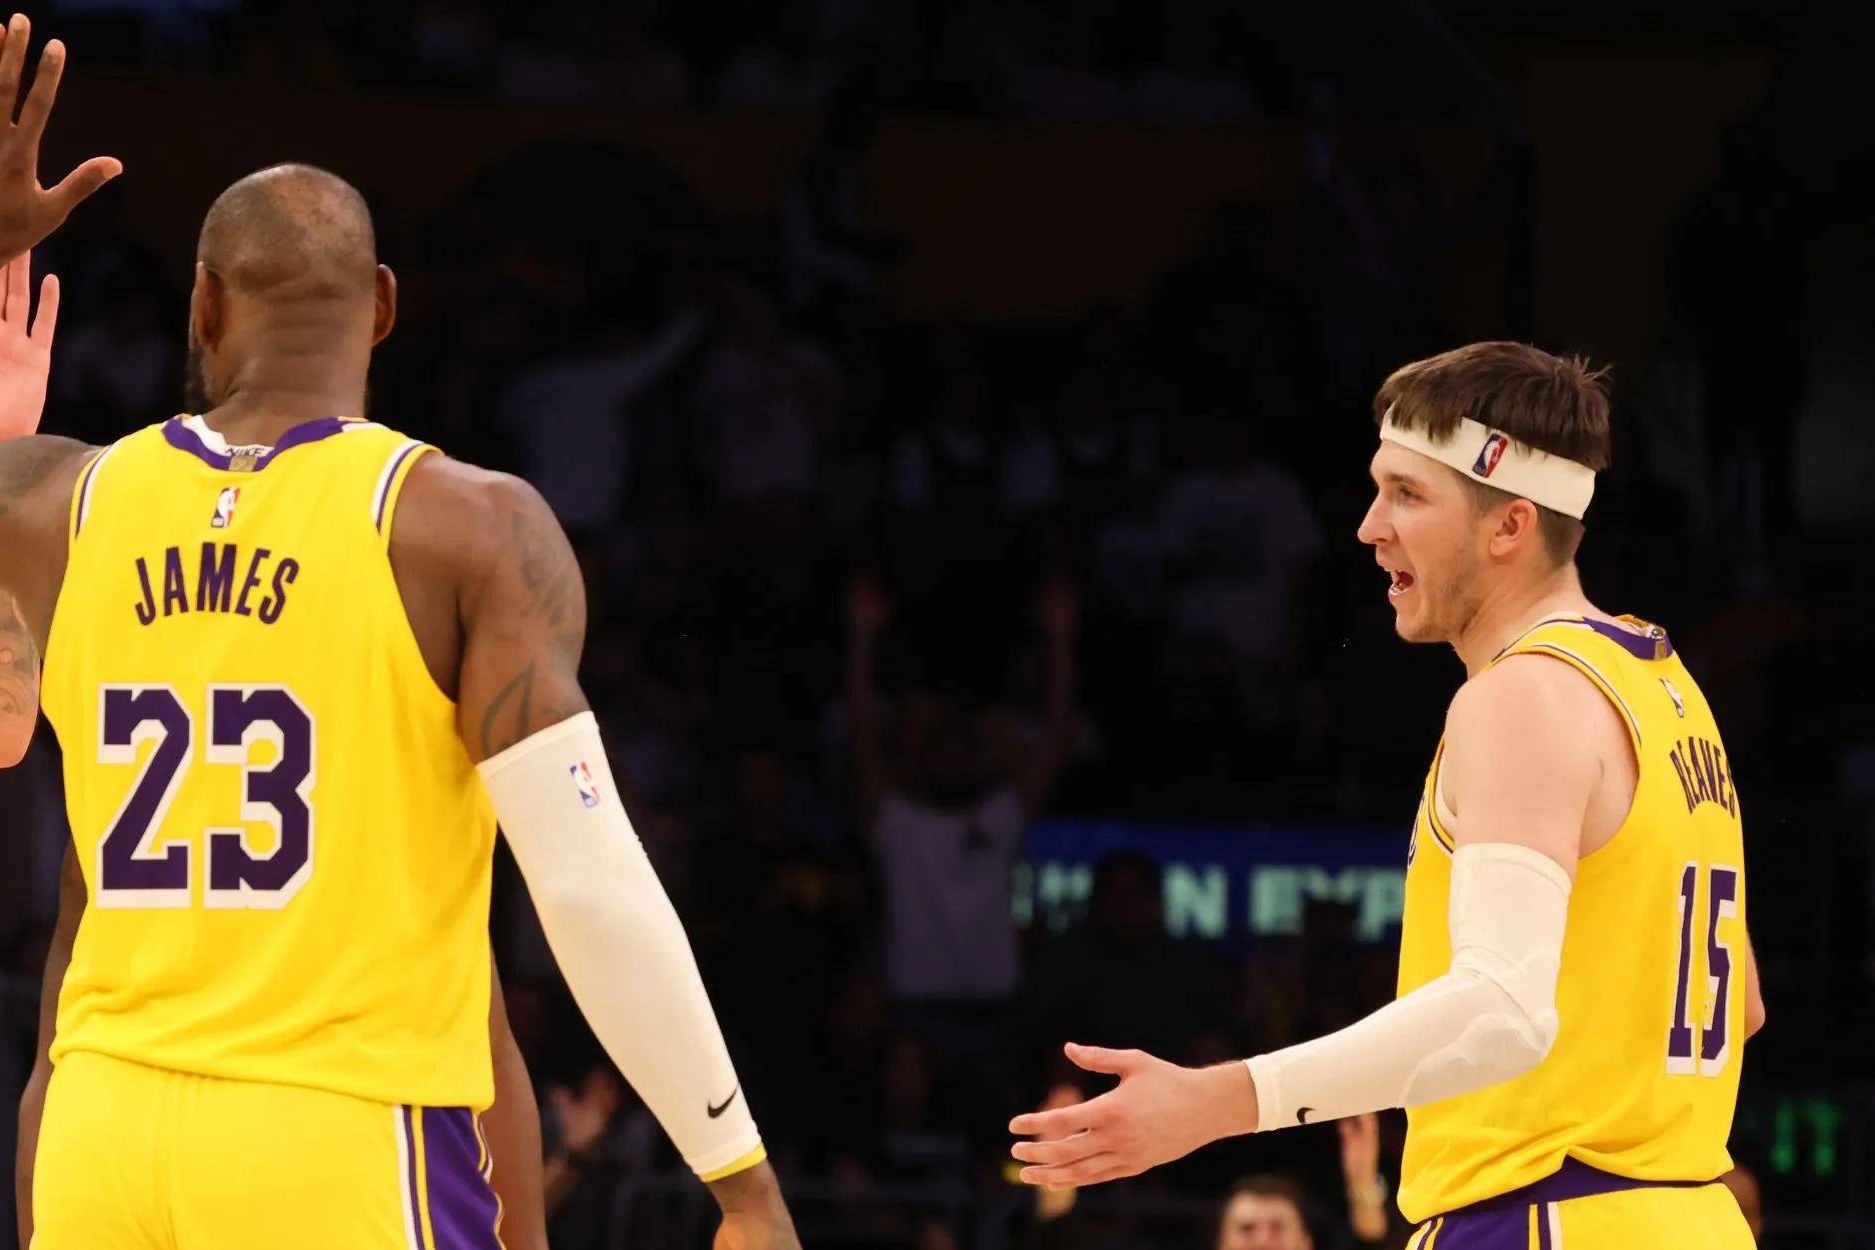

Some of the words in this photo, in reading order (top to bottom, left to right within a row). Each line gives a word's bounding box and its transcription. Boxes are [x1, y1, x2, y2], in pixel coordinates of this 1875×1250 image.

[134, 541, 300, 627] JAMES
[95, 682, 317, 910] 23
[1666, 860, 1740, 1077] 15
